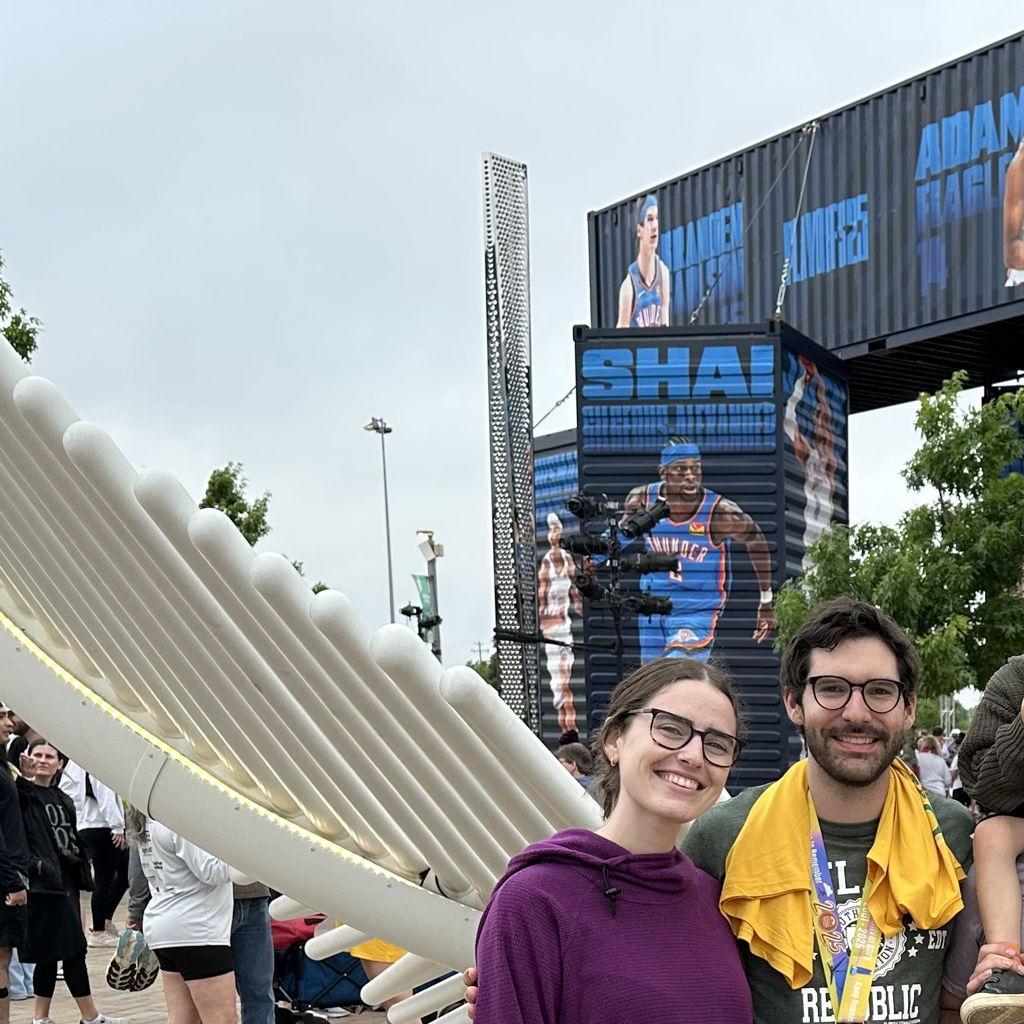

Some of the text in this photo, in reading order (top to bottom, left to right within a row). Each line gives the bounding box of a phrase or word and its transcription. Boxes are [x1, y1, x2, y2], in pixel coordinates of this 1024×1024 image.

[916, 152, 1007, 232] FLAGLE
[582, 345, 775, 399] SHAI
[645, 535, 709, 563] THUNDER
[802, 984, 922, 1023] REBLIC
